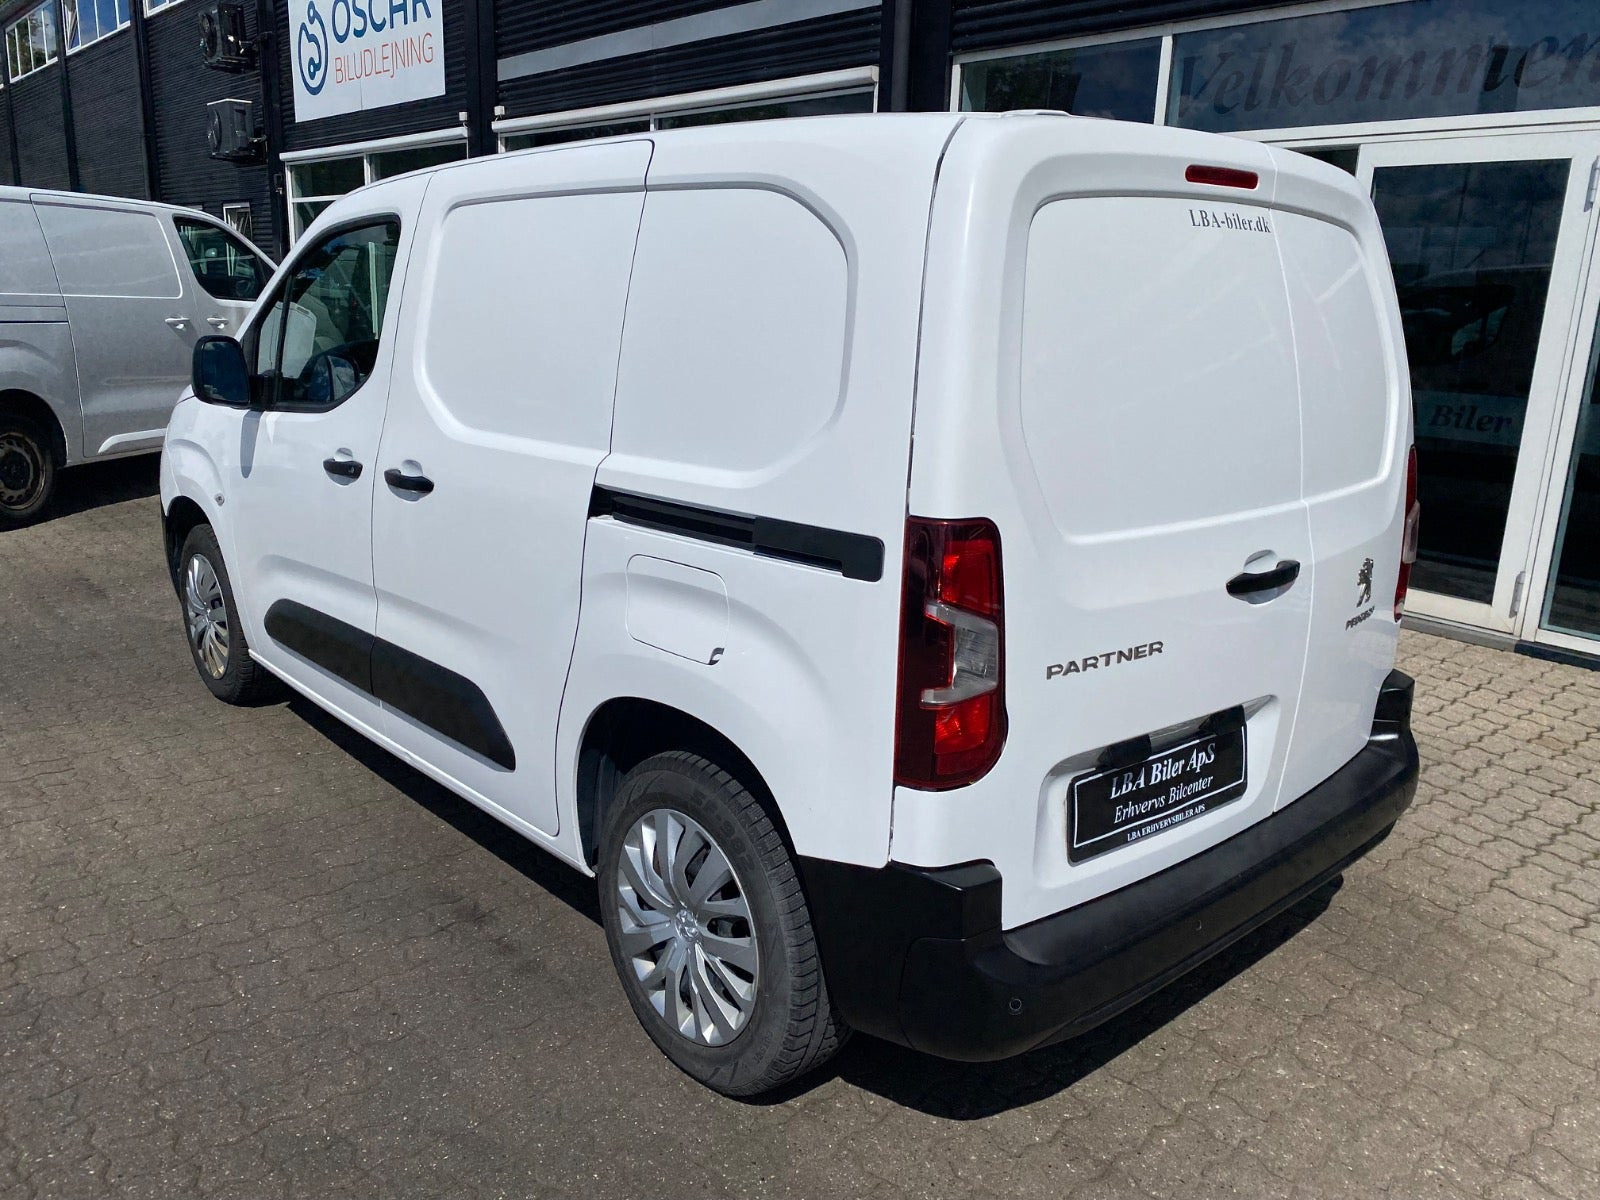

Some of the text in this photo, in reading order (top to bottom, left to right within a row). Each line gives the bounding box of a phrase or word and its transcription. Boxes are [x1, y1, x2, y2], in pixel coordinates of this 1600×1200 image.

[334, 32, 434, 84] BILUDLEJNING
[1178, 31, 1600, 119] Velkommen
[1188, 209, 1271, 233] LBA-biler.dk
[1428, 403, 1513, 434] Biler
[1046, 640, 1164, 681] PARTNER
[1110, 742, 1216, 800] LBA Biler ApS
[1113, 774, 1214, 825] Erhvervs Bilcenter
[1127, 829, 1142, 842] LBA
[1194, 804, 1206, 815] APS
